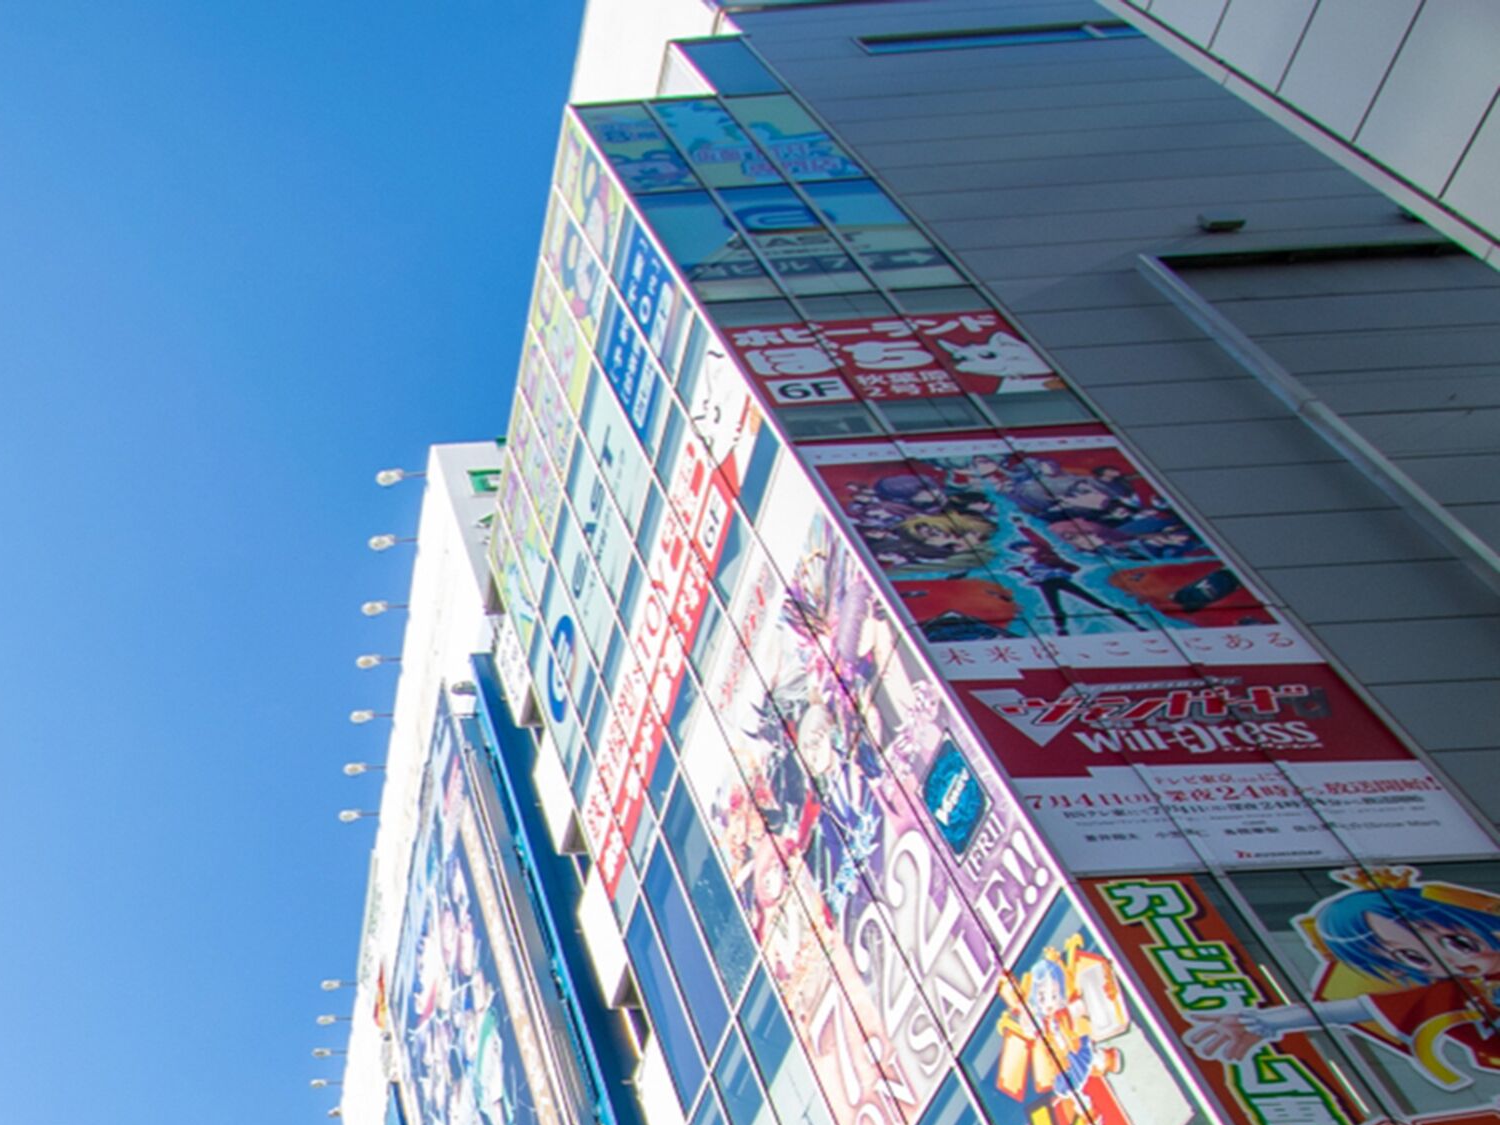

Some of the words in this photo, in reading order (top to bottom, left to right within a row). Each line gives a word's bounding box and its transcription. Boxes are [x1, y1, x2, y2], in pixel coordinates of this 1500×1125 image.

[732, 313, 996, 347] ホビーランド
[777, 380, 845, 401] 6F
[906, 828, 1050, 1080] SALE!!
